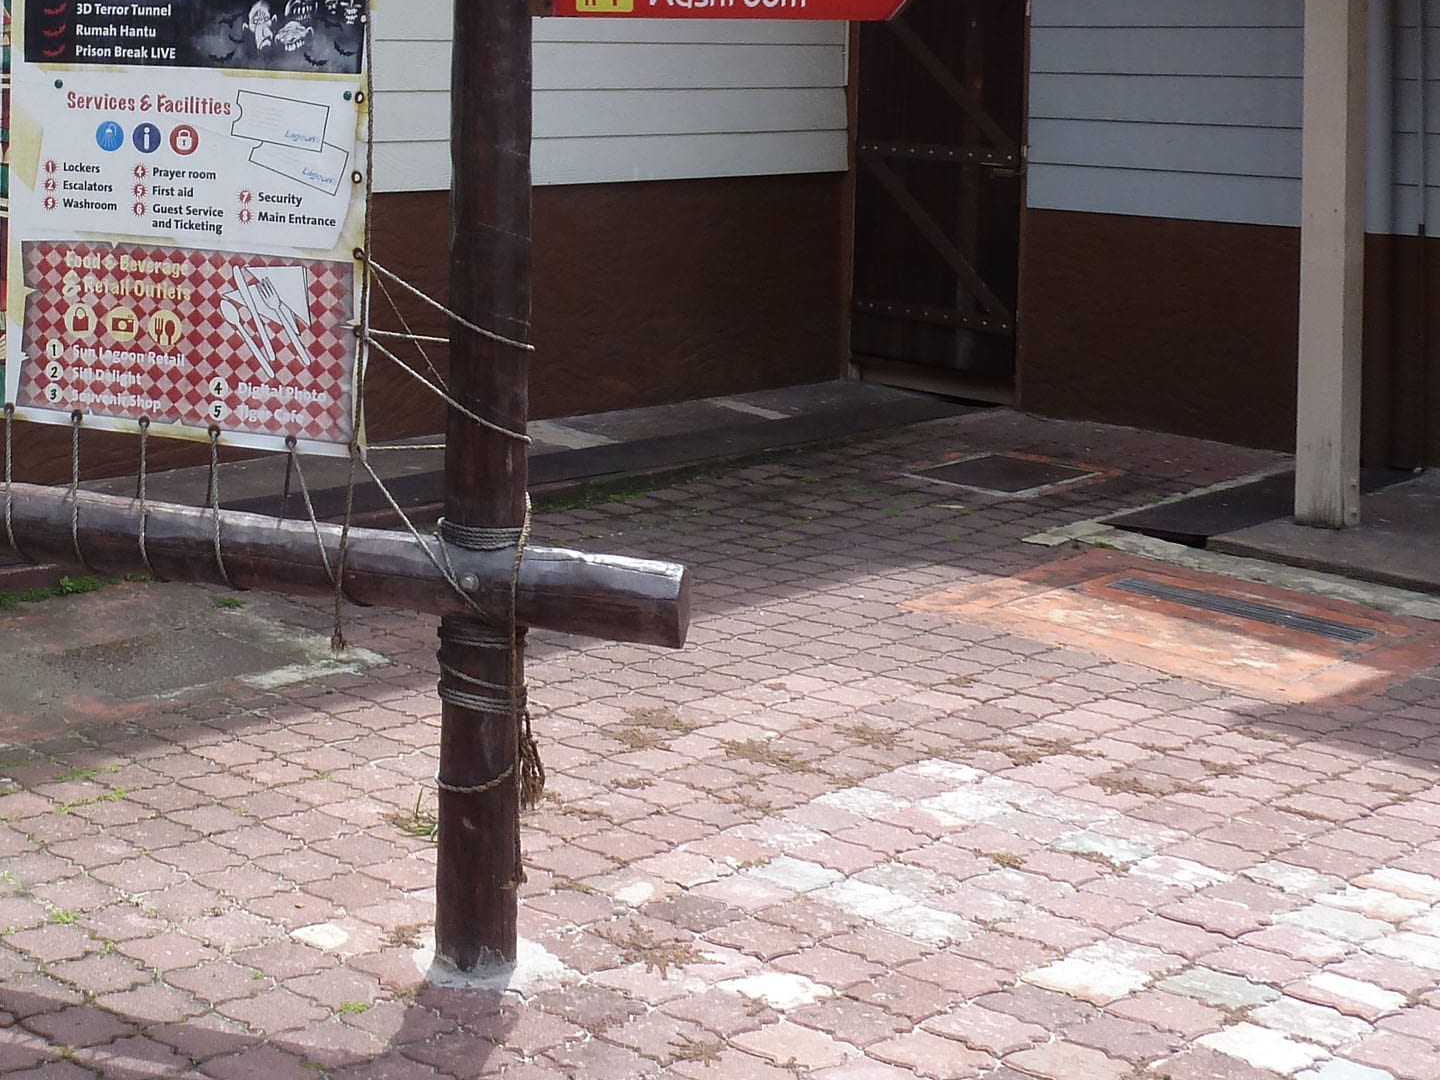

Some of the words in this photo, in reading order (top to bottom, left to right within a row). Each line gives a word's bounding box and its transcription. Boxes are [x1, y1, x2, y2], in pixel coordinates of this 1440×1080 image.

[76, 3, 92, 15] 3D
[94, 3, 129, 16] Terror
[131, 3, 172, 16] Tunnel
[76, 24, 117, 36] Rumah
[120, 25, 157, 37] Hantu
[75, 44, 111, 57] Prison
[114, 45, 148, 58] Break
[151, 47, 176, 59] LIVE
[67, 91, 135, 111] Services
[139, 94, 152, 112] &
[157, 94, 231, 116] Facilities
[63, 162, 100, 174] Lockers
[153, 167, 186, 180] Prayer
[188, 170, 216, 180] room
[63, 180, 113, 193] Escalators
[152, 186, 174, 197] First
[177, 187, 194, 198] aid
[63, 198, 117, 211] Washroom
[258, 192, 303, 207] Security
[152, 204, 183, 216] Guest
[186, 205, 224, 218] Service
[257, 211, 286, 224] Main
[289, 214, 336, 227] Entrance
[152, 219, 171, 229] and
[174, 220, 223, 235] Ticketing
[120, 255, 190, 278] Beverage
[134, 280, 191, 301] Outlets
[72, 344, 95, 358] Sun
[100, 347, 145, 363] Lagoon
[148, 351, 185, 367] Retail
[238, 382, 282, 399] Digital
[286, 386, 327, 400] Photo
[130, 395, 161, 412] Shop
